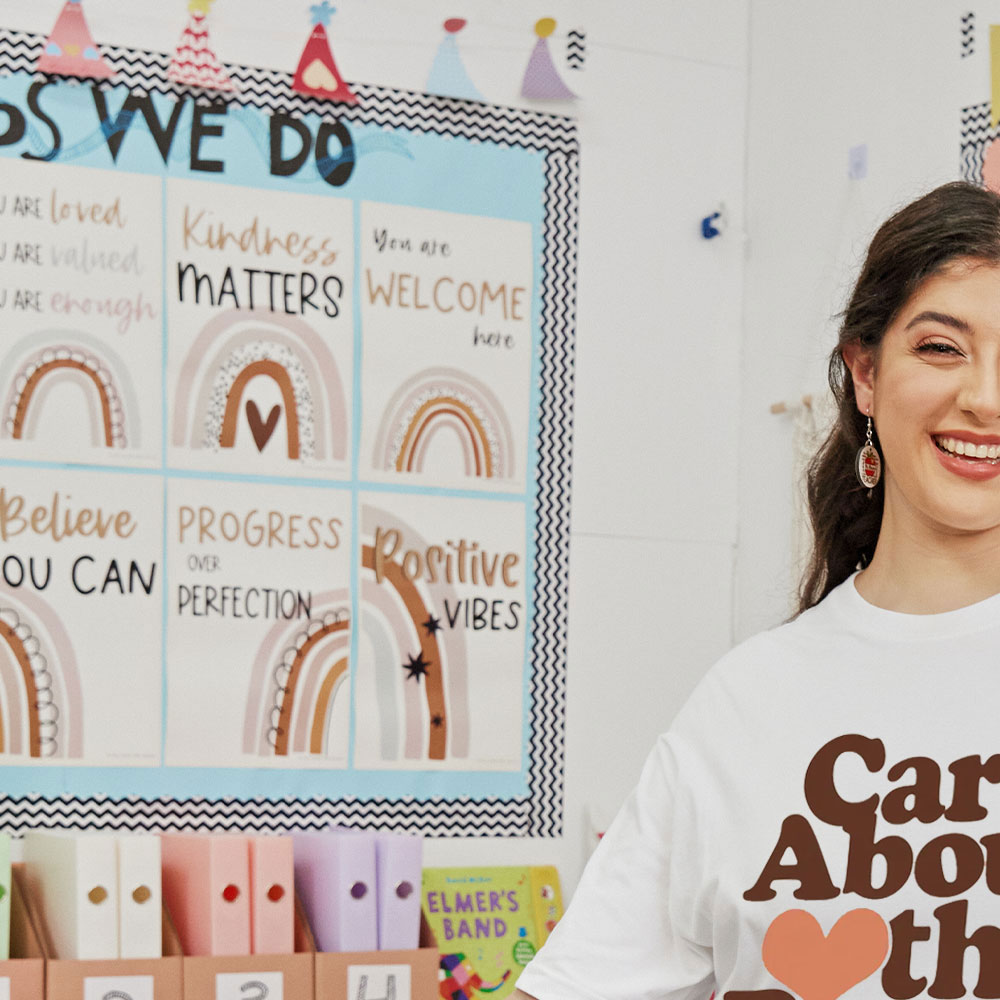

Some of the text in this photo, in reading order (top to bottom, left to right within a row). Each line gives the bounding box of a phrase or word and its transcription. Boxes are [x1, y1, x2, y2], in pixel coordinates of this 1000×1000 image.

[91, 85, 228, 173] WE
[270, 112, 355, 187] DO
[50, 188, 127, 229] loved
[184, 205, 338, 266] Kindness
[51, 237, 144, 275] valued
[50, 291, 156, 335] enough
[366, 268, 526, 321] WELCOME
[473, 326, 516, 349] here
[0, 487, 137, 542] Believe
[178, 506, 343, 549] PROGRESS
[2, 555, 156, 595] OU CAN
[188, 554, 220, 573] OVER
[375, 526, 520, 588] Positive
[178, 584, 312, 620] PERFECTION
[444, 597, 521, 631] VIBES
[427, 889, 519, 913] ELMER'S
[443, 917, 507, 940] BAND
